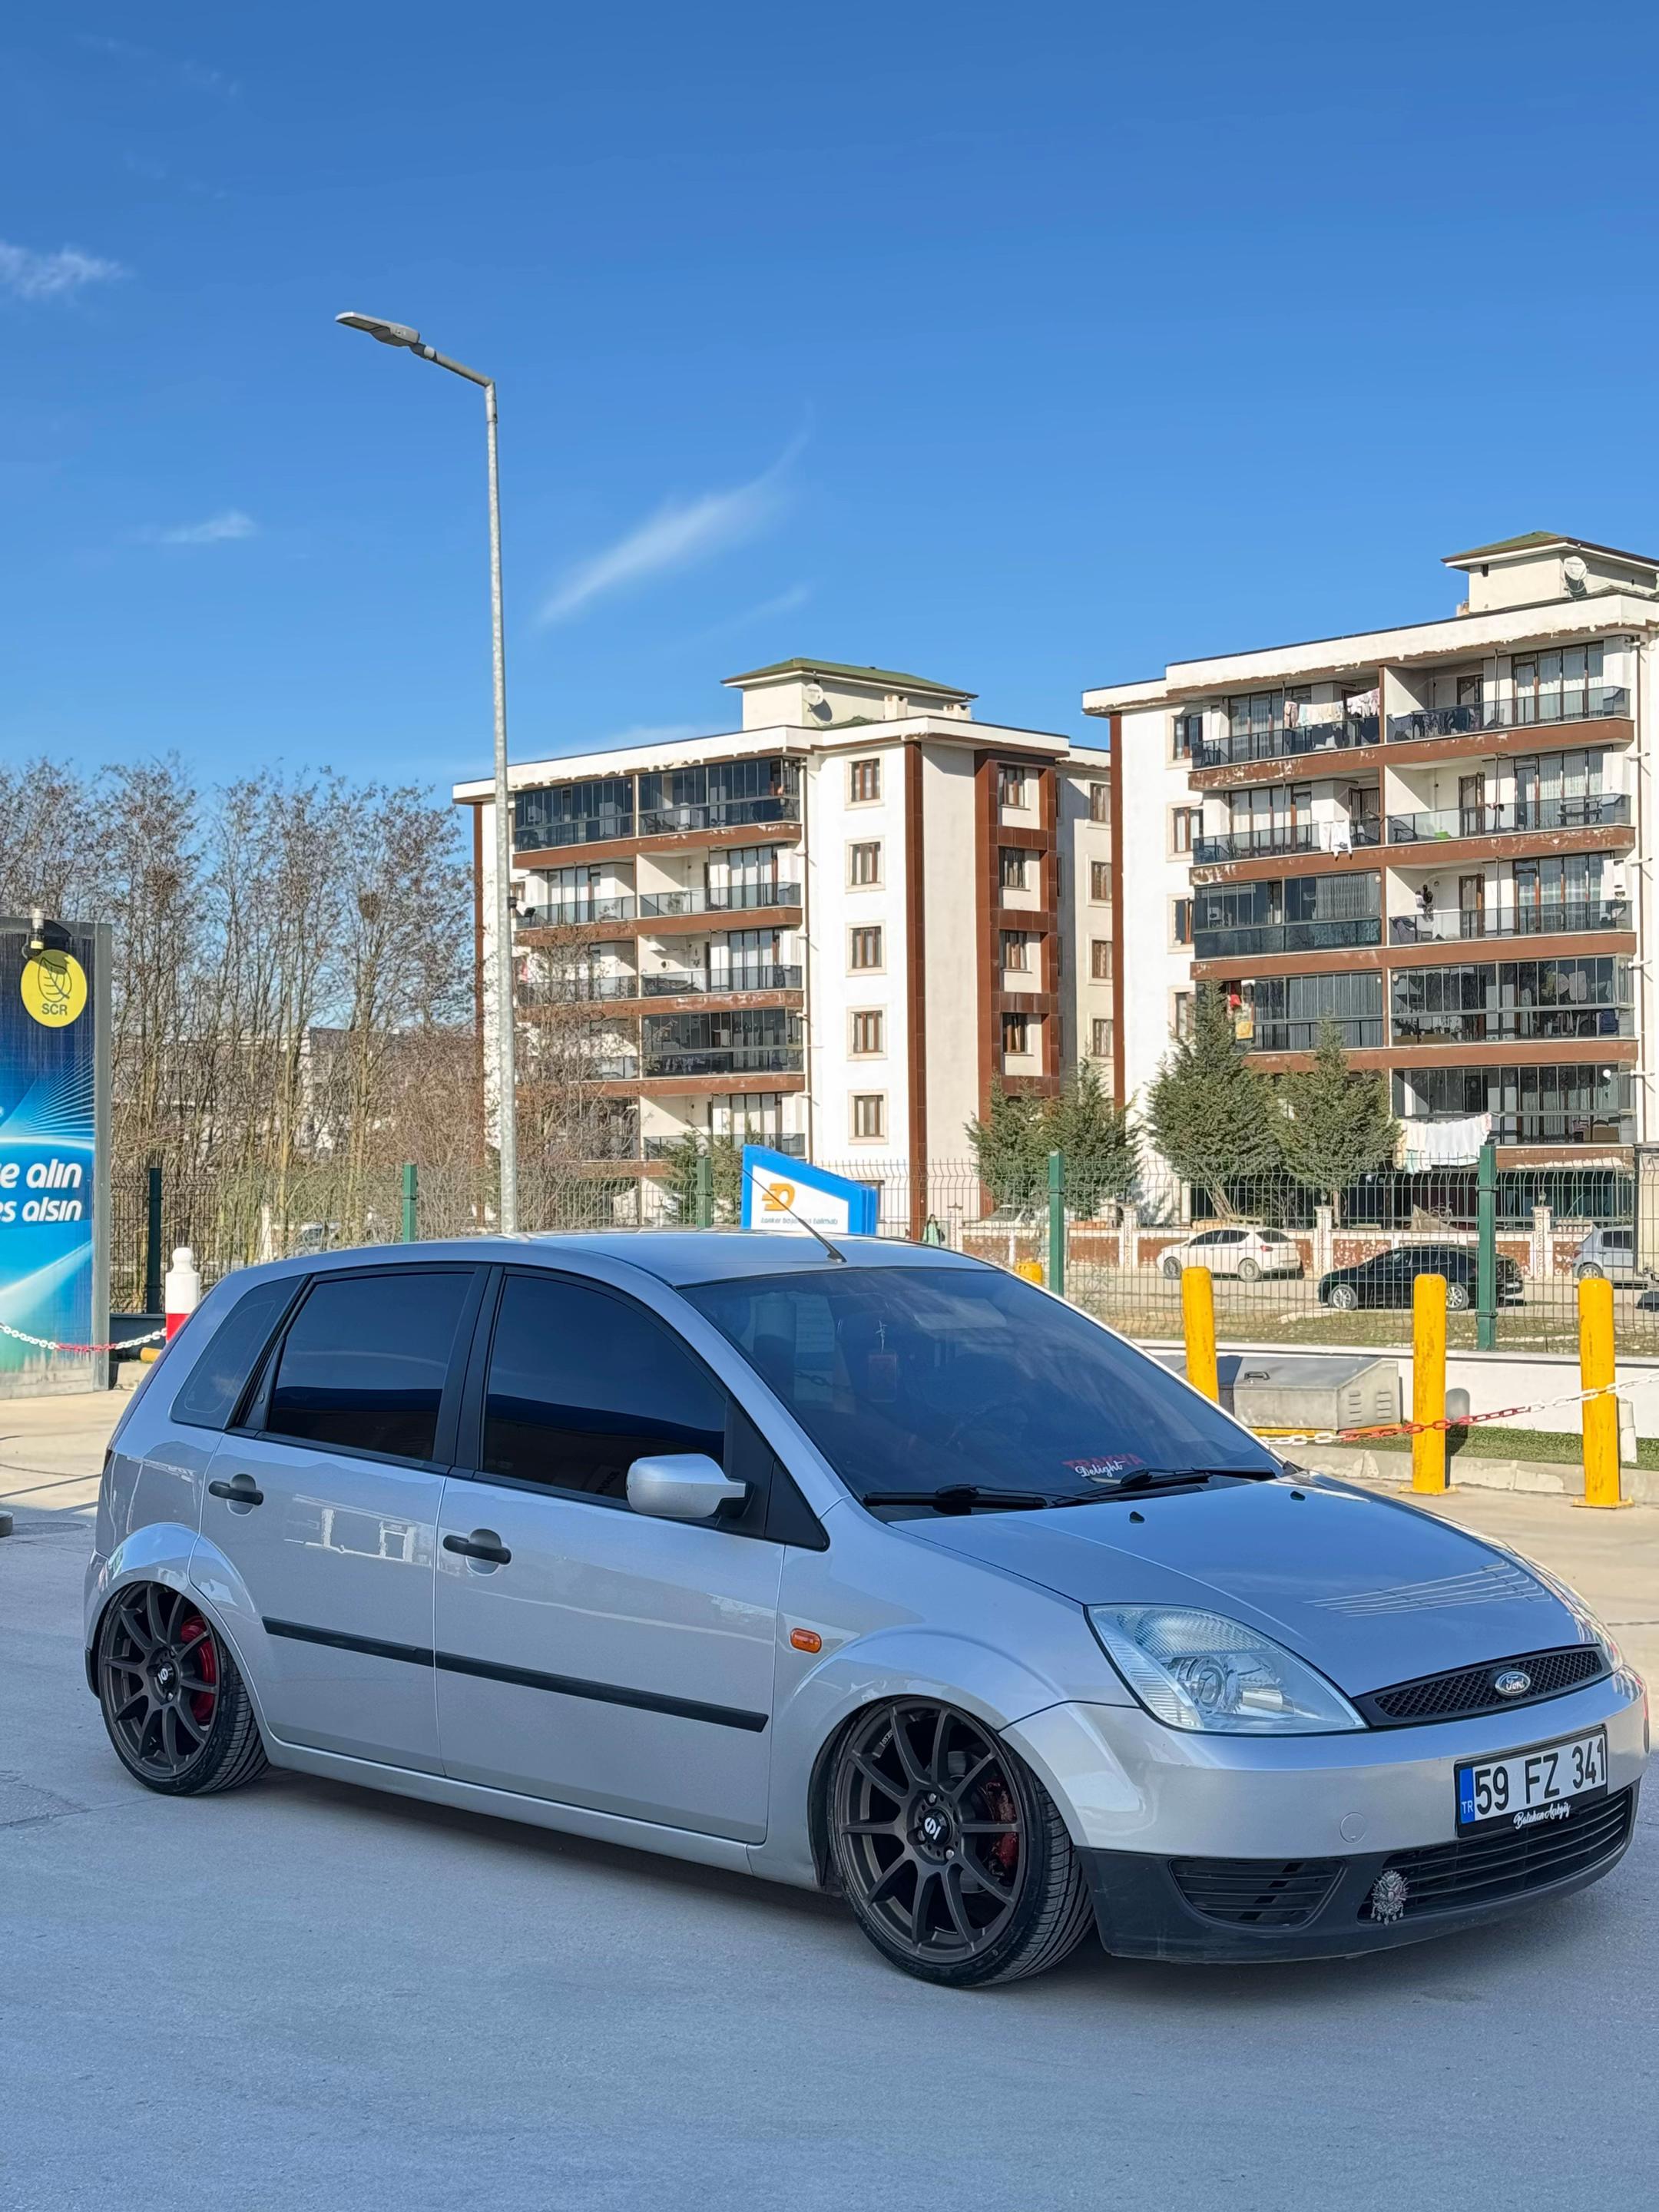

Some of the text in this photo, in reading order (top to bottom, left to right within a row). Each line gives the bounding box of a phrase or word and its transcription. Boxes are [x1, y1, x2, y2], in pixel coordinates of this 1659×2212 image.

[41, 1003, 68, 1015] SCR
[26, 1158, 82, 1188] alın
[22, 1197, 82, 1221] alsın
[1075, 1460, 1126, 1478] Delight
[1505, 1676, 1525, 1691] Ford
[1462, 1737, 1605, 1815] TR 59 FZ 341
